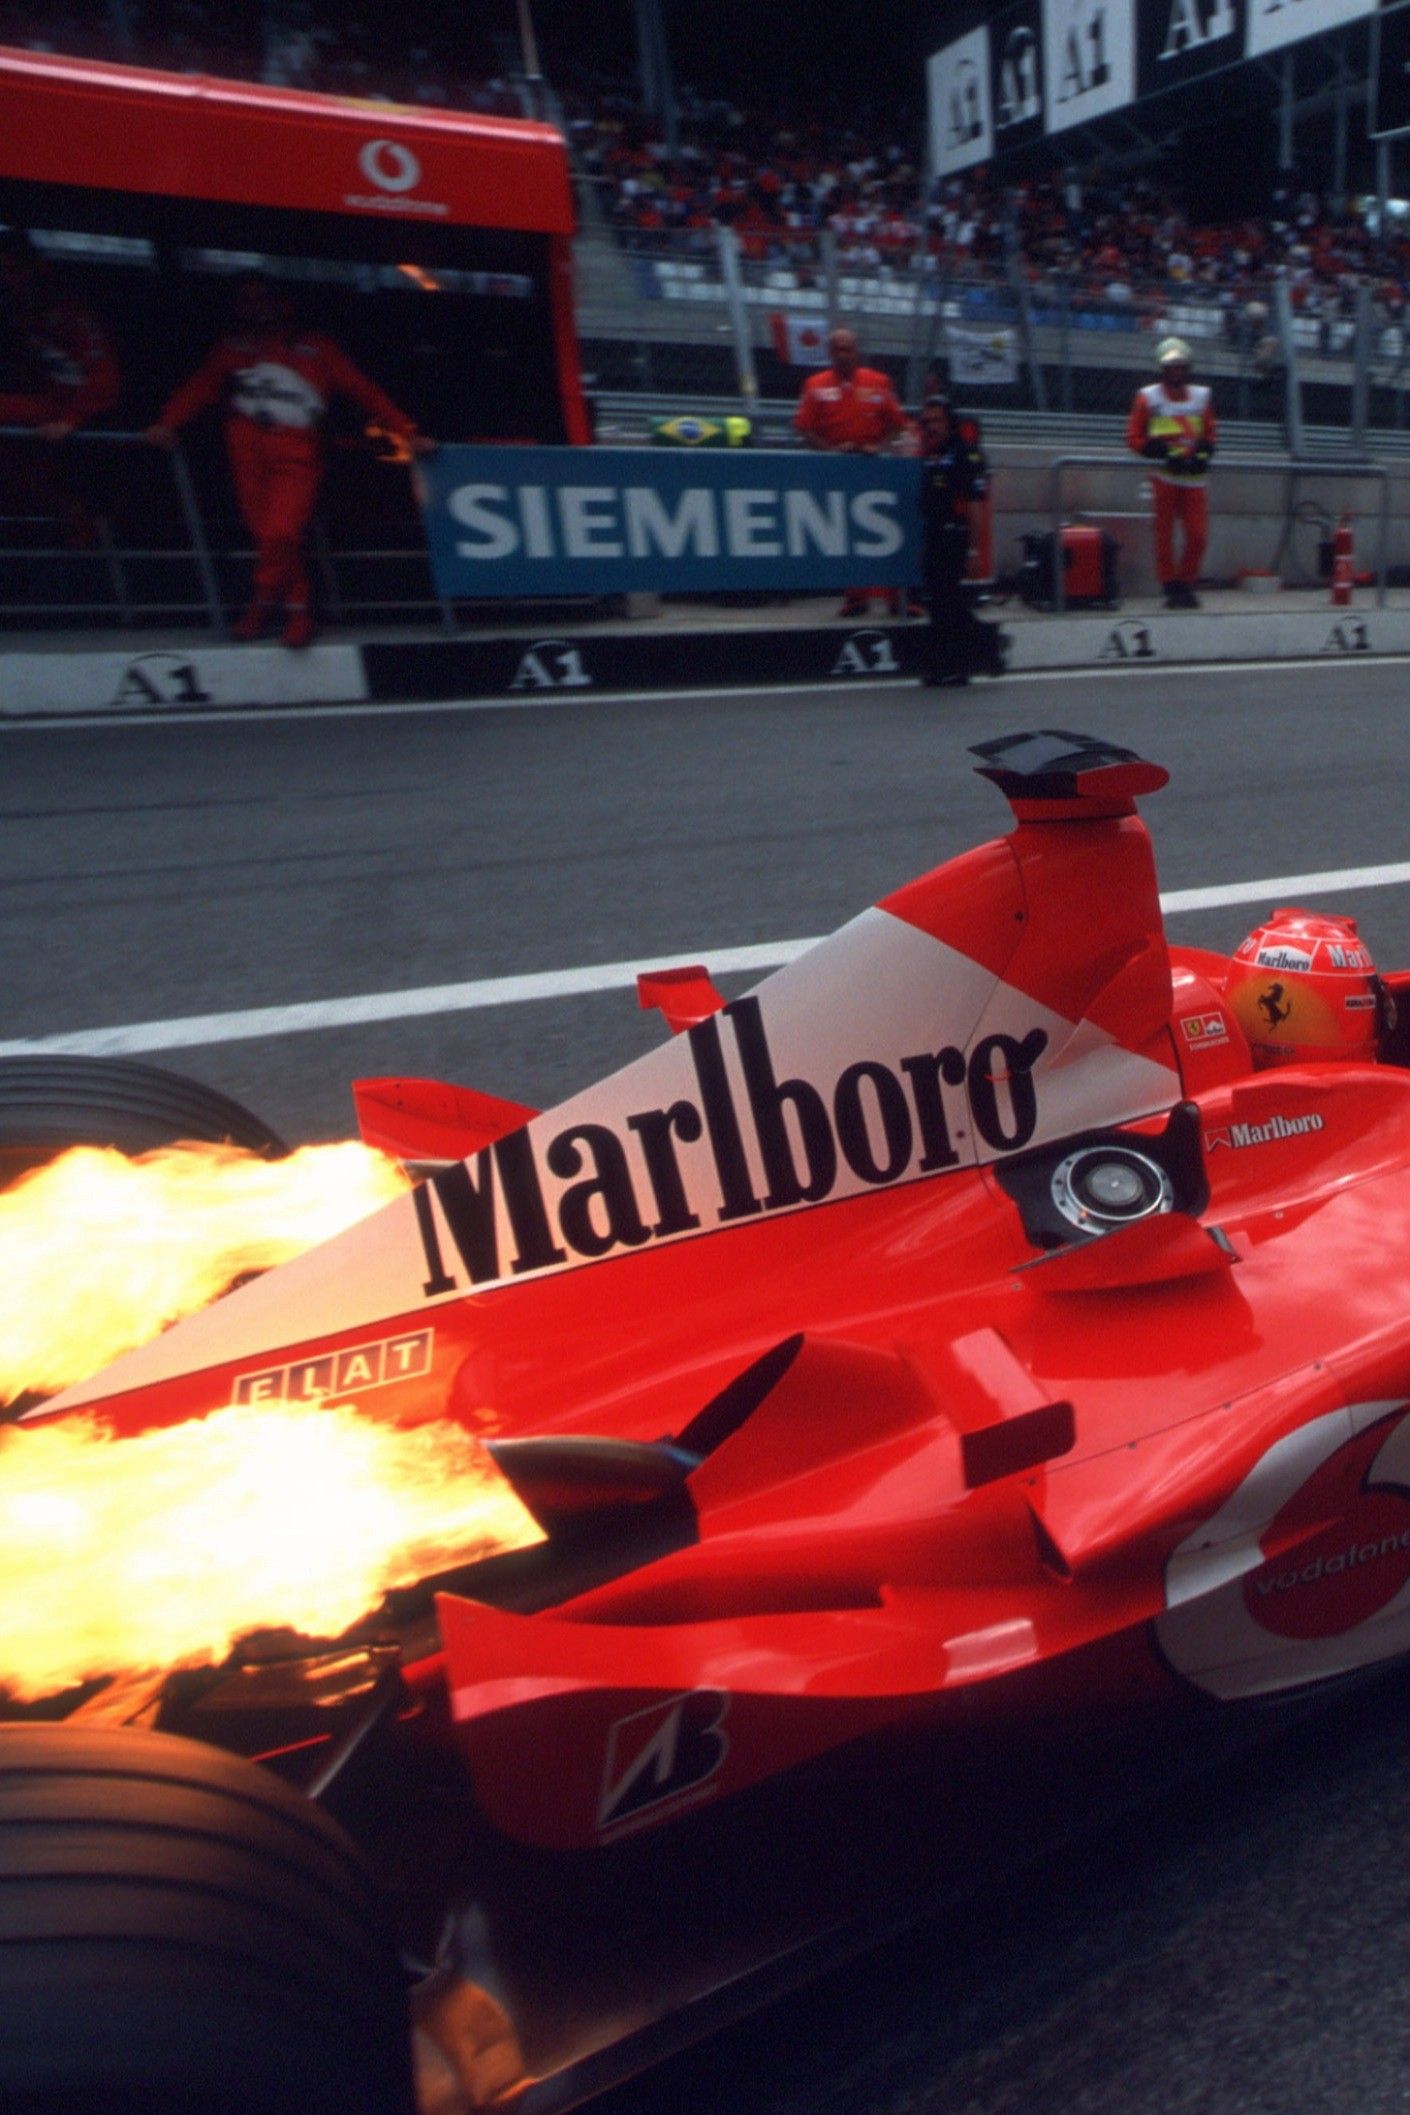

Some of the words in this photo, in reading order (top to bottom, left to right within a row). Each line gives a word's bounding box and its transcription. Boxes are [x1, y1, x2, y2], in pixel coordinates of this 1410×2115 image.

[449, 483, 904, 559] SIEMENS
[831, 637, 900, 675] A1
[1100, 629, 1157, 660] A1
[1321, 624, 1372, 653] A1
[112, 664, 211, 704] A1
[508, 649, 592, 688] A1
[1258, 950, 1310, 971] Marlboro
[413, 995, 1048, 1297] Marlboro
[1231, 1114, 1324, 1148] Marlboro
